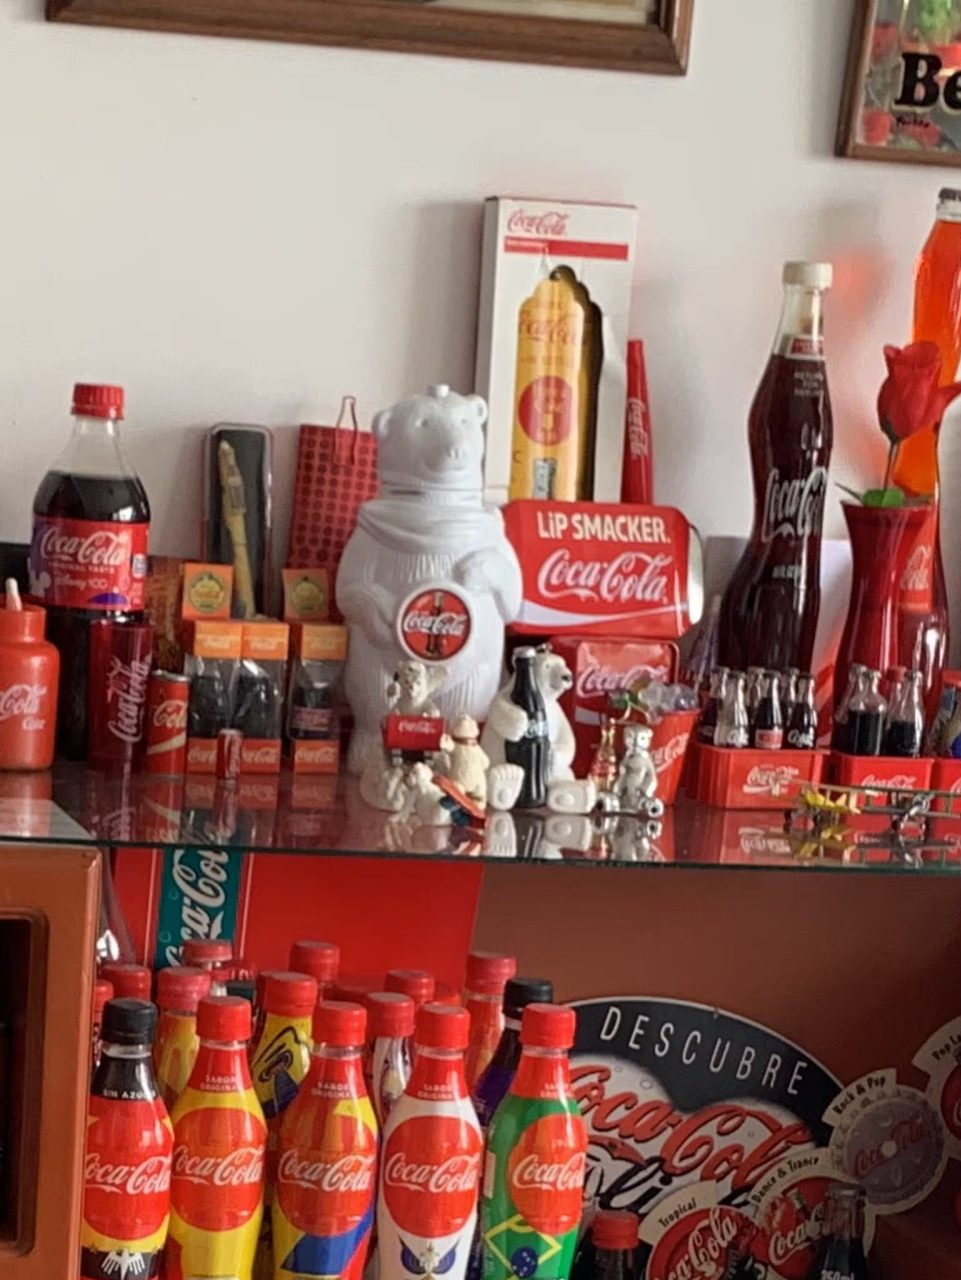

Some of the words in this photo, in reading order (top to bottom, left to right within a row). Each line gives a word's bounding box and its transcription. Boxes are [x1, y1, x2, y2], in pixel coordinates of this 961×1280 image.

[507, 209, 570, 236] Coca-Cola
[41, 526, 128, 566] Coca-Cola
[538, 548, 673, 604] Coca-Cola
[403, 610, 468, 637] Coca-Cola
[108, 655, 152, 744] Coca-Cola
[600, 1006, 808, 1096] DESCUBRE
[385, 1151, 480, 1194] Coca-Cola
[657, 1196, 698, 1229] Tropical
